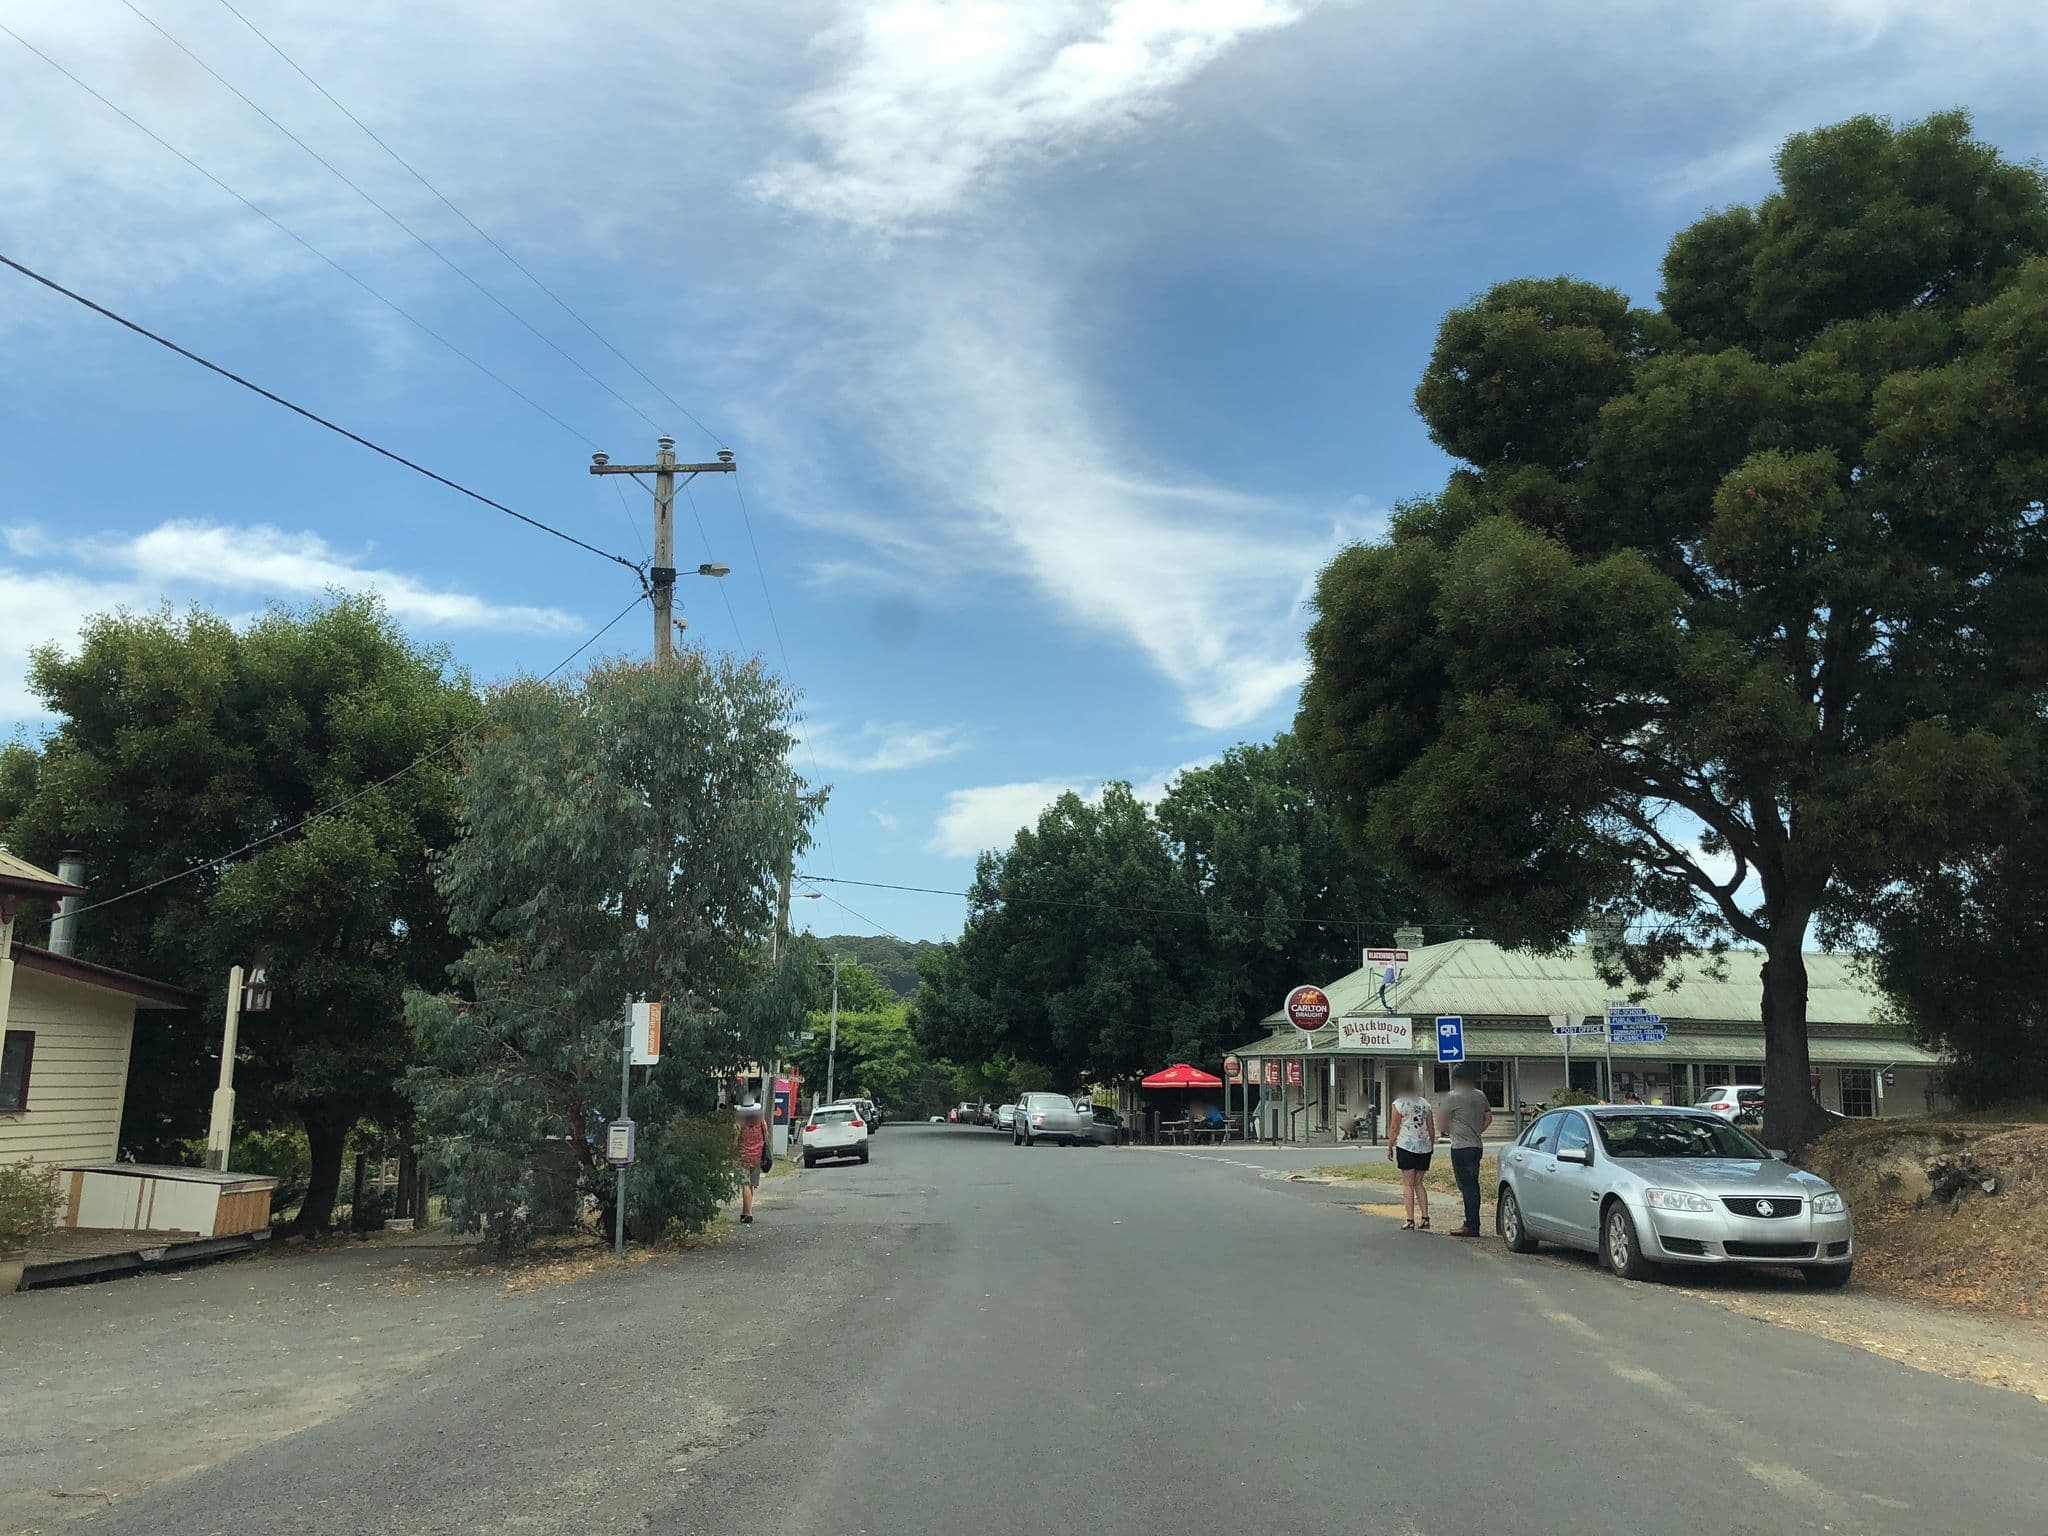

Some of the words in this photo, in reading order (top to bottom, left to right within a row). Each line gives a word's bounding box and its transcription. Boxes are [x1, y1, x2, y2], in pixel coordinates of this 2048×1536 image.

[1291, 1004, 1327, 1012] CARLTON
[1342, 1020, 1407, 1037] Blackwood
[1360, 1033, 1391, 1046] Hotel
